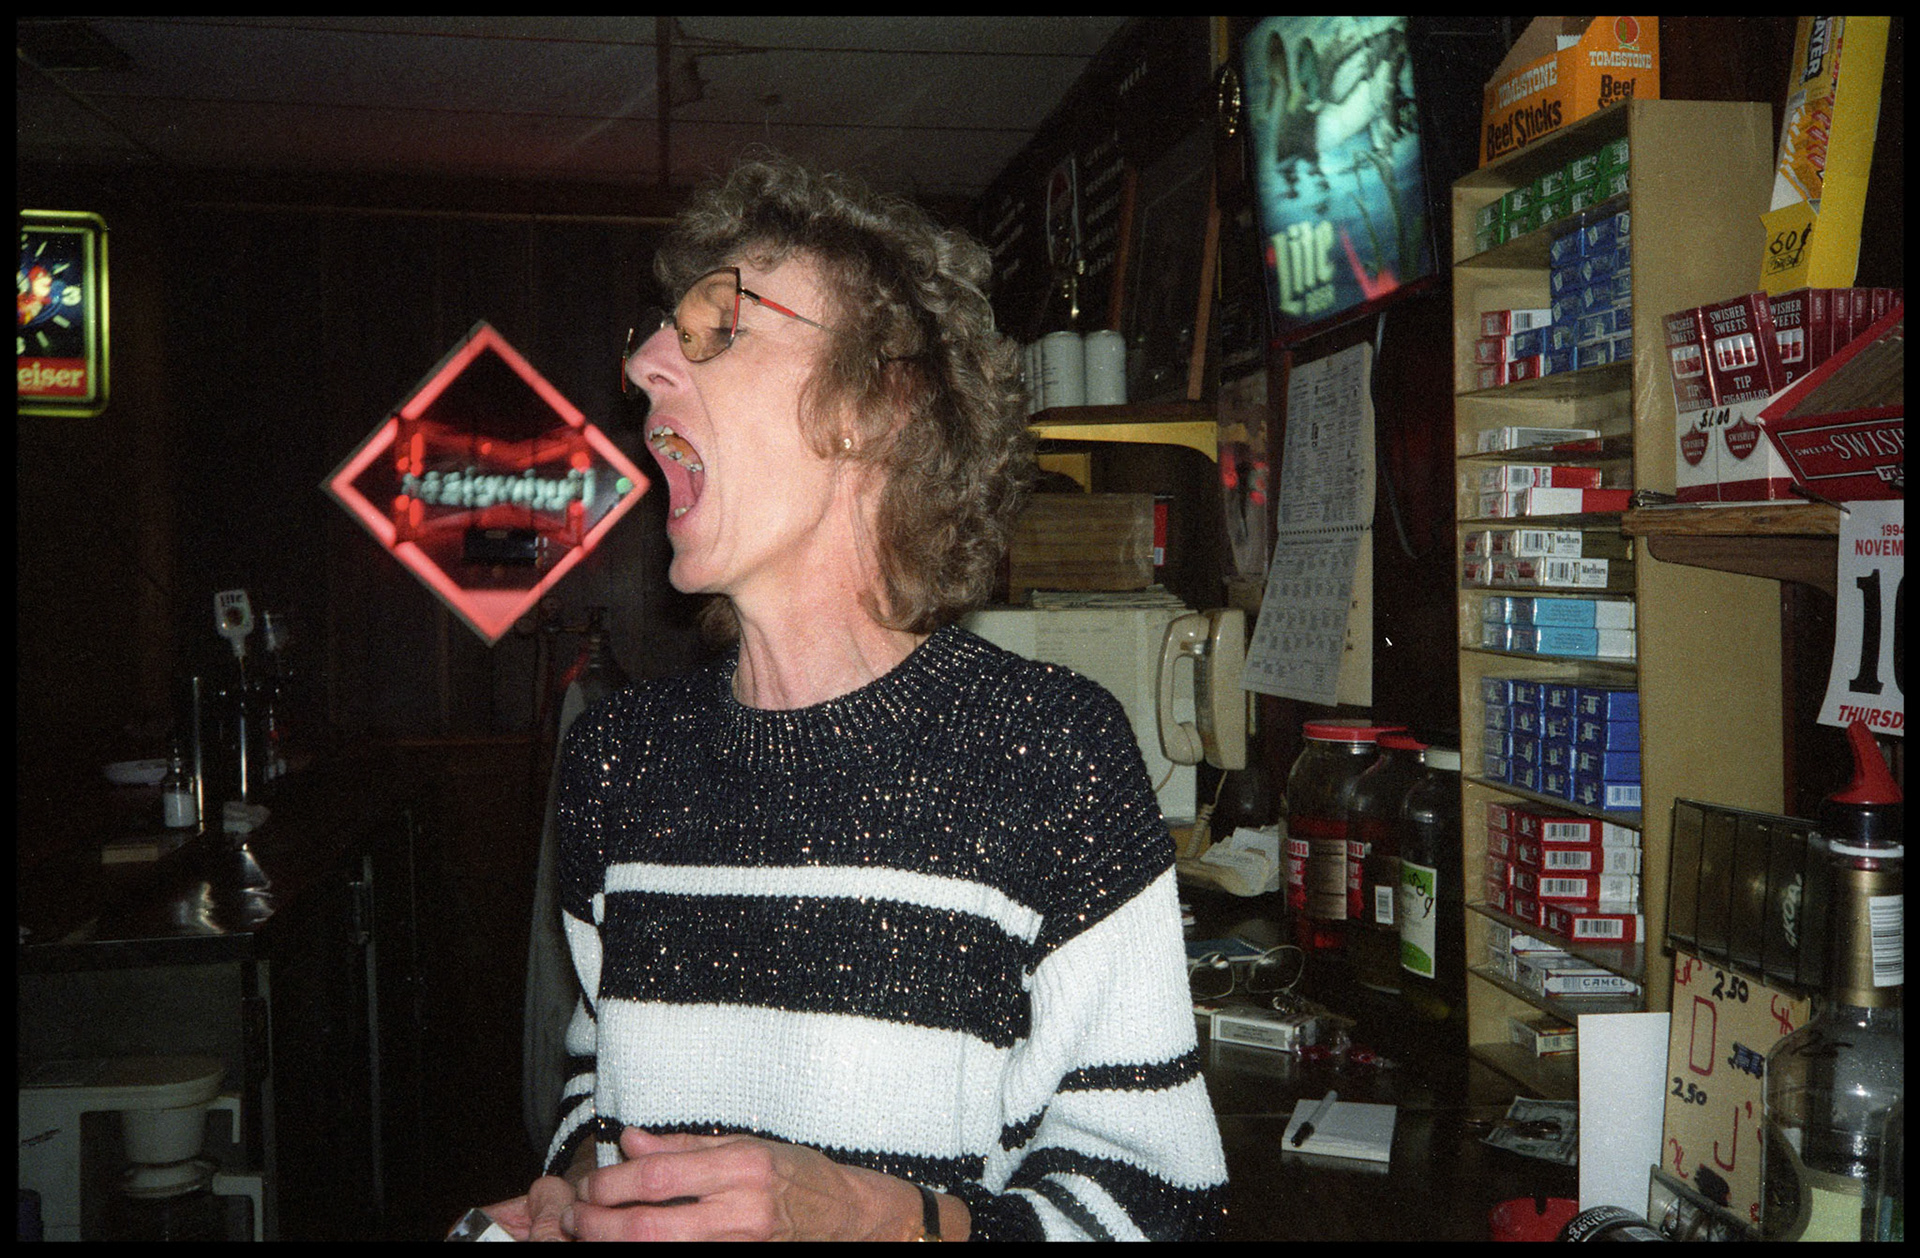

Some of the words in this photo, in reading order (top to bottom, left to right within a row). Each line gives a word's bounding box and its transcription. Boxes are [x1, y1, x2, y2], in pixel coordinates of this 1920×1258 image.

[1807, 14, 1826, 75] AYER
[1588, 51, 1652, 69] TOMBSTONE
[1600, 74, 1636, 98] Beef
[1486, 113, 1514, 162] Beef
[1514, 99, 1562, 148] Sticks
[1709, 305, 1747, 324] SWISHER
[1770, 299, 1802, 315] WISHER
[1713, 317, 1748, 336] SWEETS
[17, 361, 84, 387] eiser
[1733, 375, 1752, 390] TIP
[1686, 384, 1700, 398] TIP
[1722, 388, 1770, 406] CIGARILLOS
[1728, 431, 1756, 443] SWISHER
[1795, 444, 1834, 457] SWEETS
[1854, 539, 1904, 557] NOVEM
[1848, 568, 1904, 696] 1
[1837, 704, 1904, 731] THURSD
[1582, 978, 1627, 987] CAMEL
